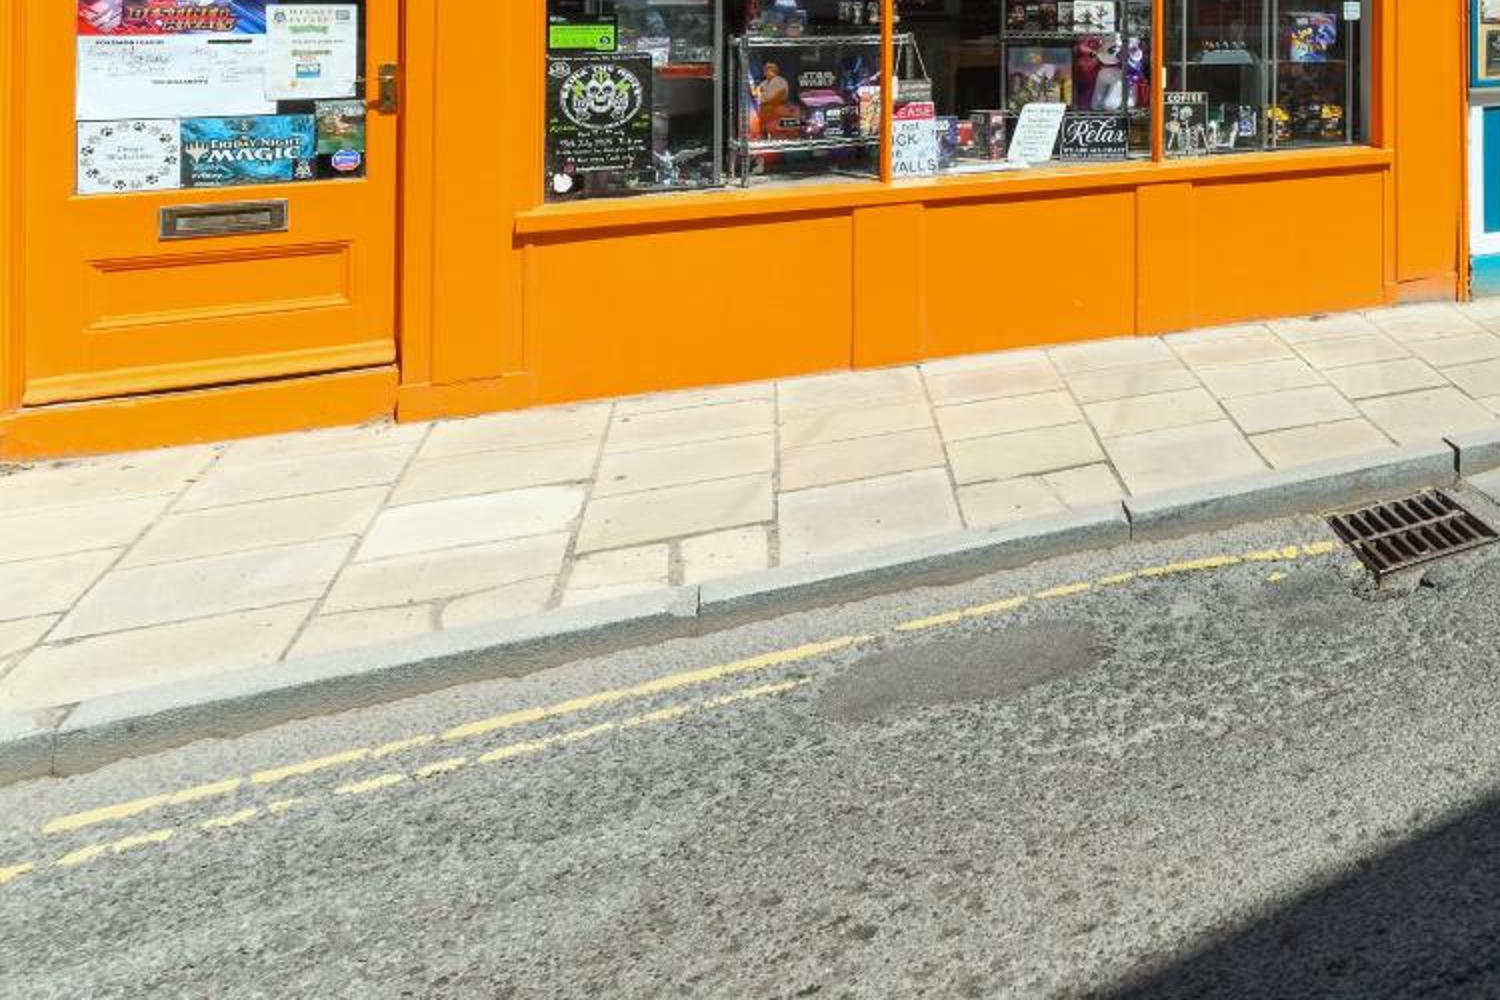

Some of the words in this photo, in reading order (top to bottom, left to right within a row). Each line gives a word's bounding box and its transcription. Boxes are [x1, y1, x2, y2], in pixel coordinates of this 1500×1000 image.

[1167, 92, 1204, 103] COFFEE
[1066, 118, 1127, 147] Relax
[208, 146, 301, 163] MAGIC
